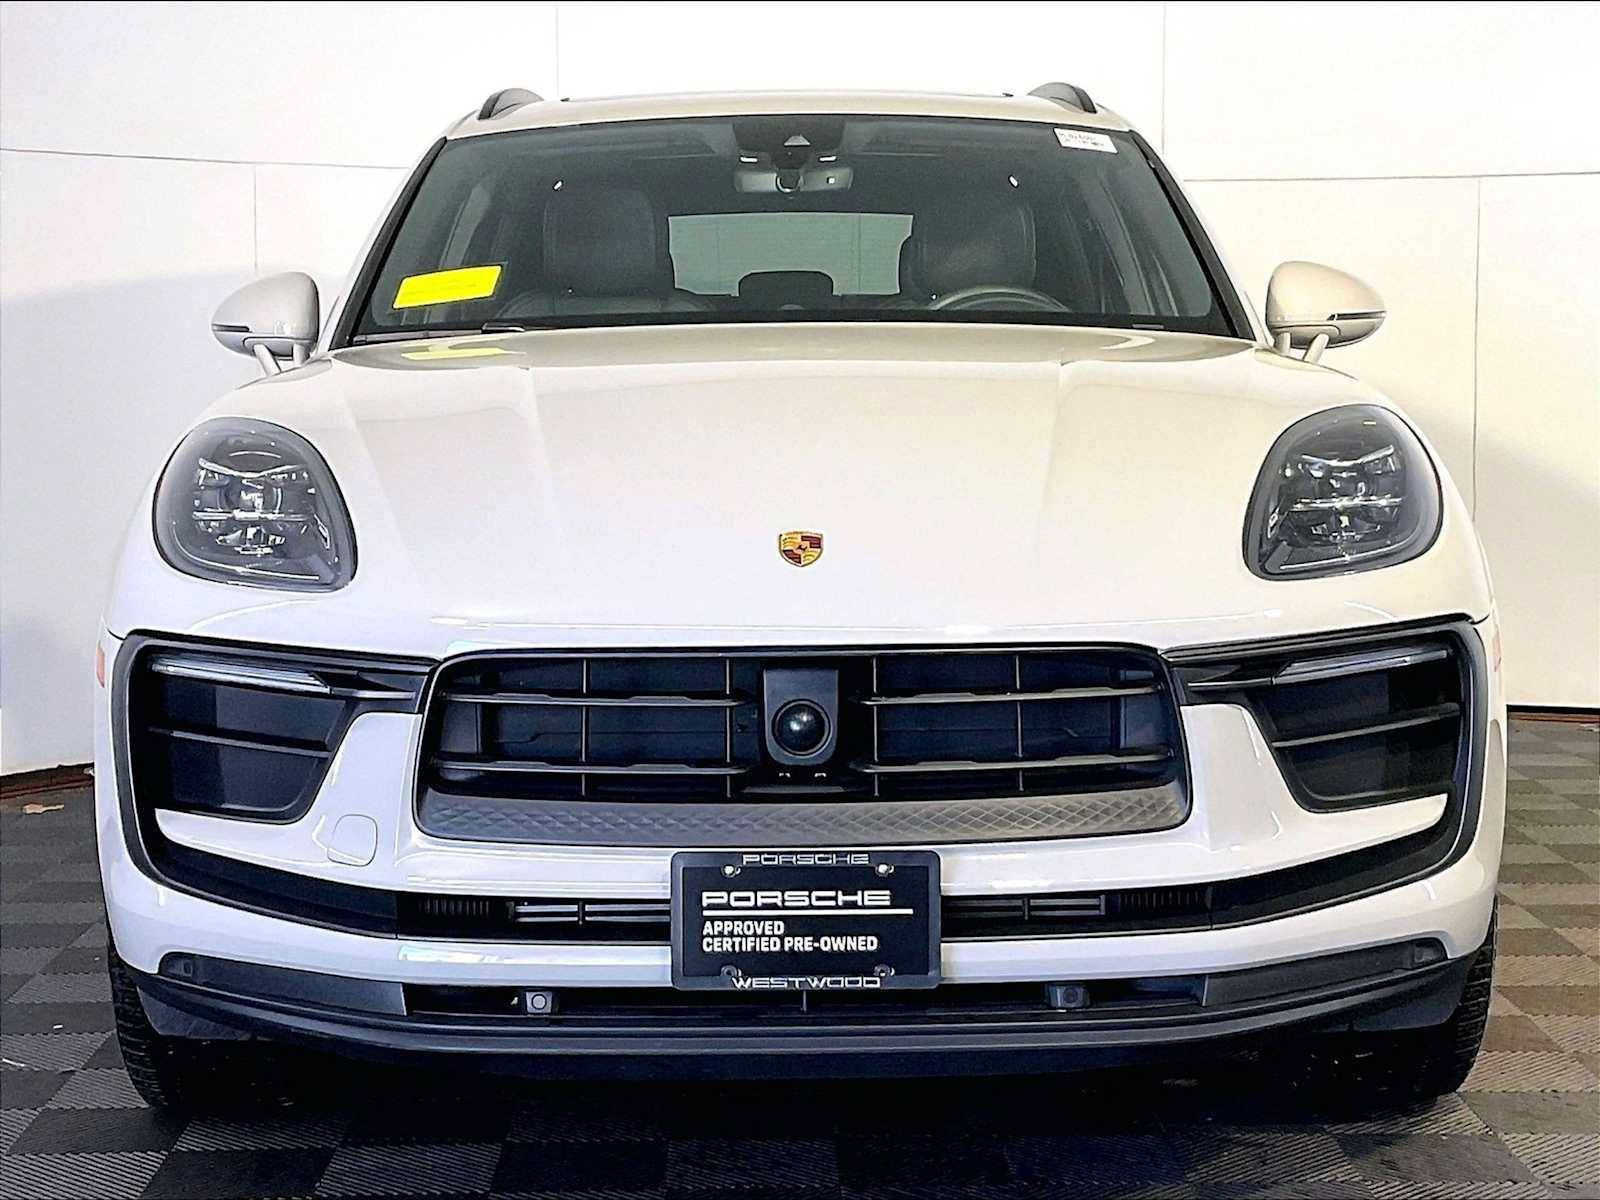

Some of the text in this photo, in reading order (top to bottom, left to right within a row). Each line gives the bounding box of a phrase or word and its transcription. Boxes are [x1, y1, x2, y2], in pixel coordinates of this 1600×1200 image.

[742, 853, 869, 865] PORSCHE
[702, 890, 891, 908] PORSCHE
[702, 920, 785, 936] APPROVED
[702, 935, 879, 952] CERTIFIED PRE-OWNED
[731, 976, 881, 990] WESTWOOD
